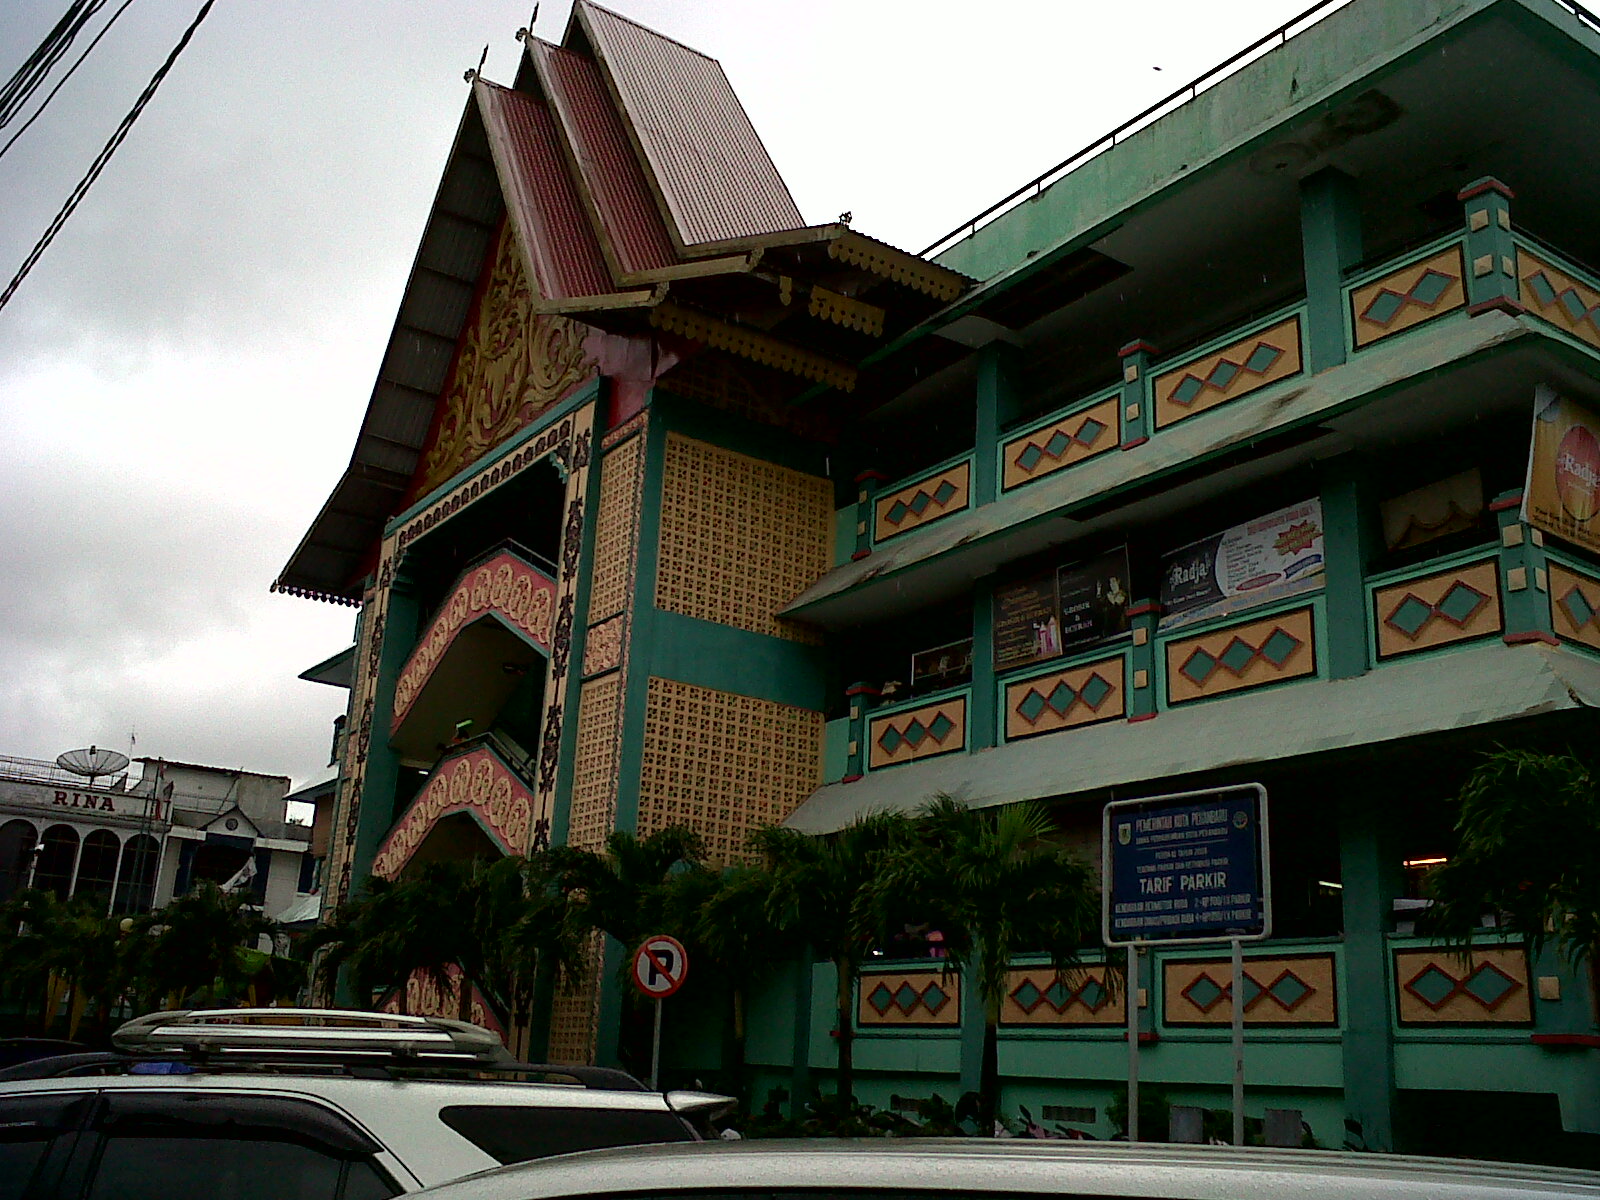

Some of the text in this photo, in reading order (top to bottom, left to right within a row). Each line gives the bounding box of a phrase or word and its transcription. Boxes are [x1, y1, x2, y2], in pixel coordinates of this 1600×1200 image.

[52, 790, 115, 812] RINA
[1139, 871, 1226, 895] TARIF PARKIR
[648, 950, 674, 985] P
